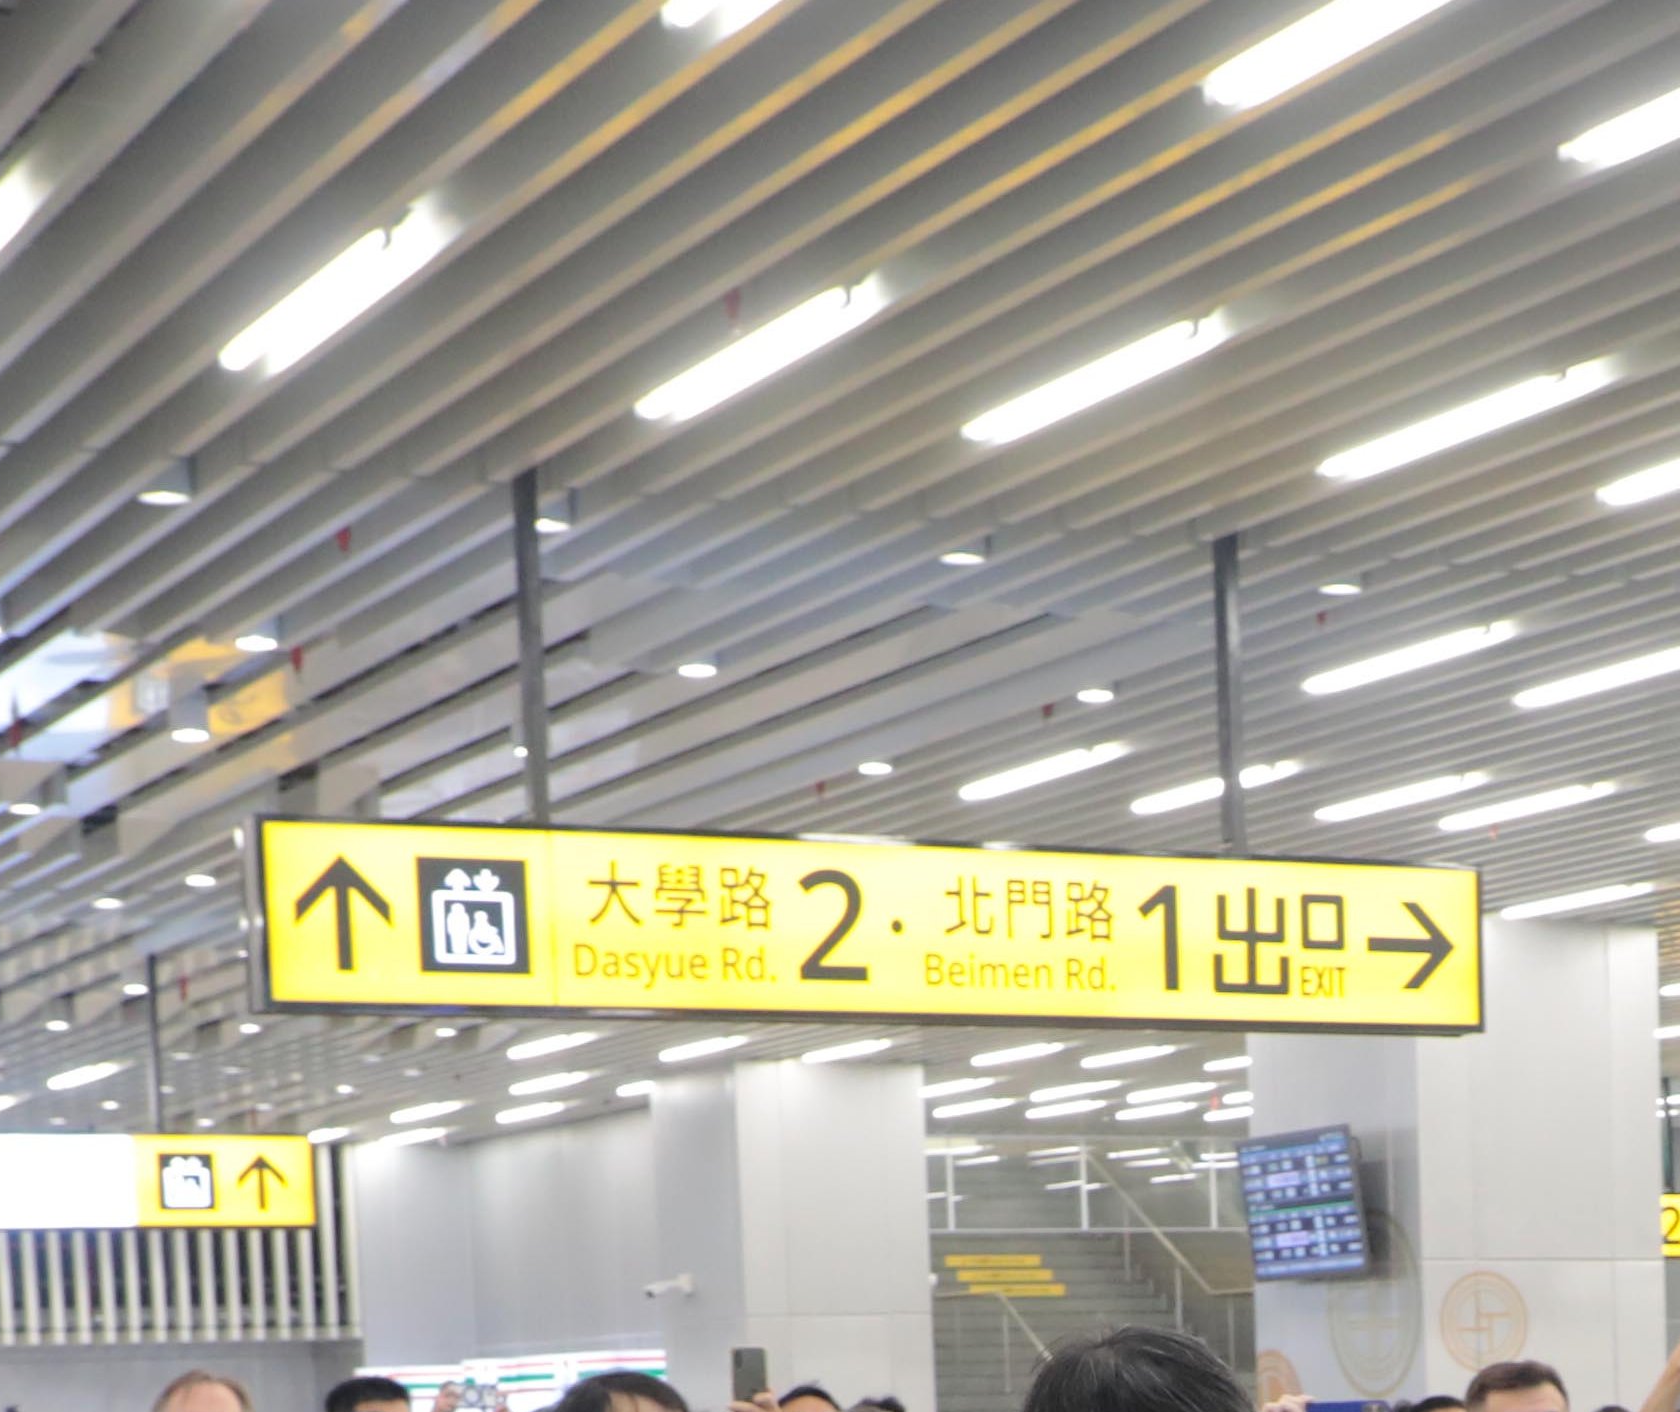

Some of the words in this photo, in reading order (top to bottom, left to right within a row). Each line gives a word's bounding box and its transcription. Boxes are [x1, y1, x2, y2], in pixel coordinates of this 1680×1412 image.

[573, 943, 709, 990] Dasyue
[721, 946, 777, 982] Rd.
[924, 953, 1053, 988] Beimen
[1066, 956, 1117, 992] Rd.
[1300, 966, 1346, 997] EXIT
[587, 860, 770, 929] 大學路
[798, 869, 868, 981] 2
[944, 876, 1113, 940] 北門路
[1138, 884, 1180, 991] 1
[1213, 887, 1345, 995] 出口
